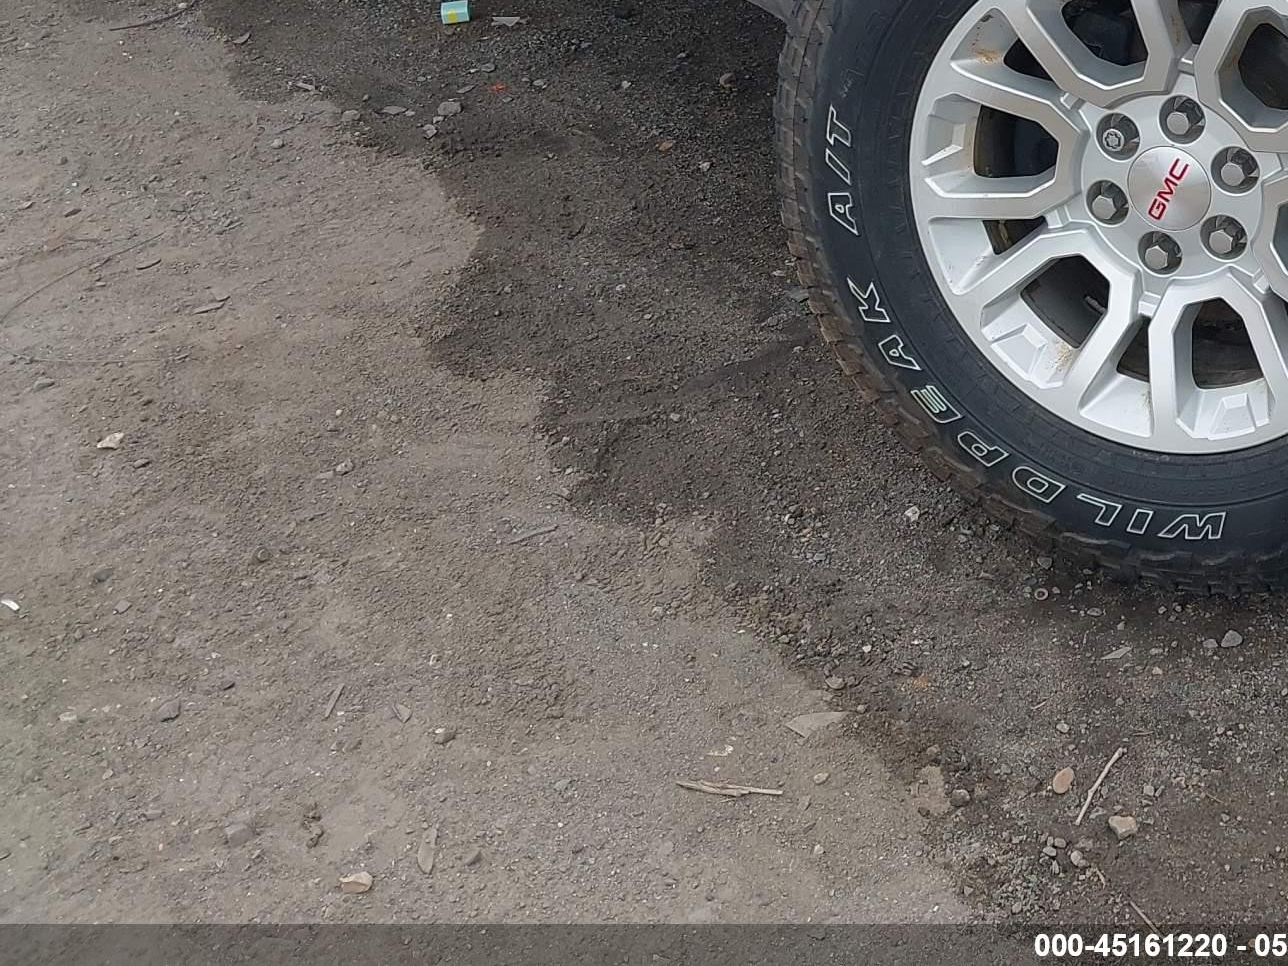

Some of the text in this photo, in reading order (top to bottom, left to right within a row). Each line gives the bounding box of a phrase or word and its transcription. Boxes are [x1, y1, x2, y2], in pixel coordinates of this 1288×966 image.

[825, 103, 860, 237] A/T
[1147, 157, 1190, 222] GMC
[847, 275, 1227, 541] WILDPEAK
